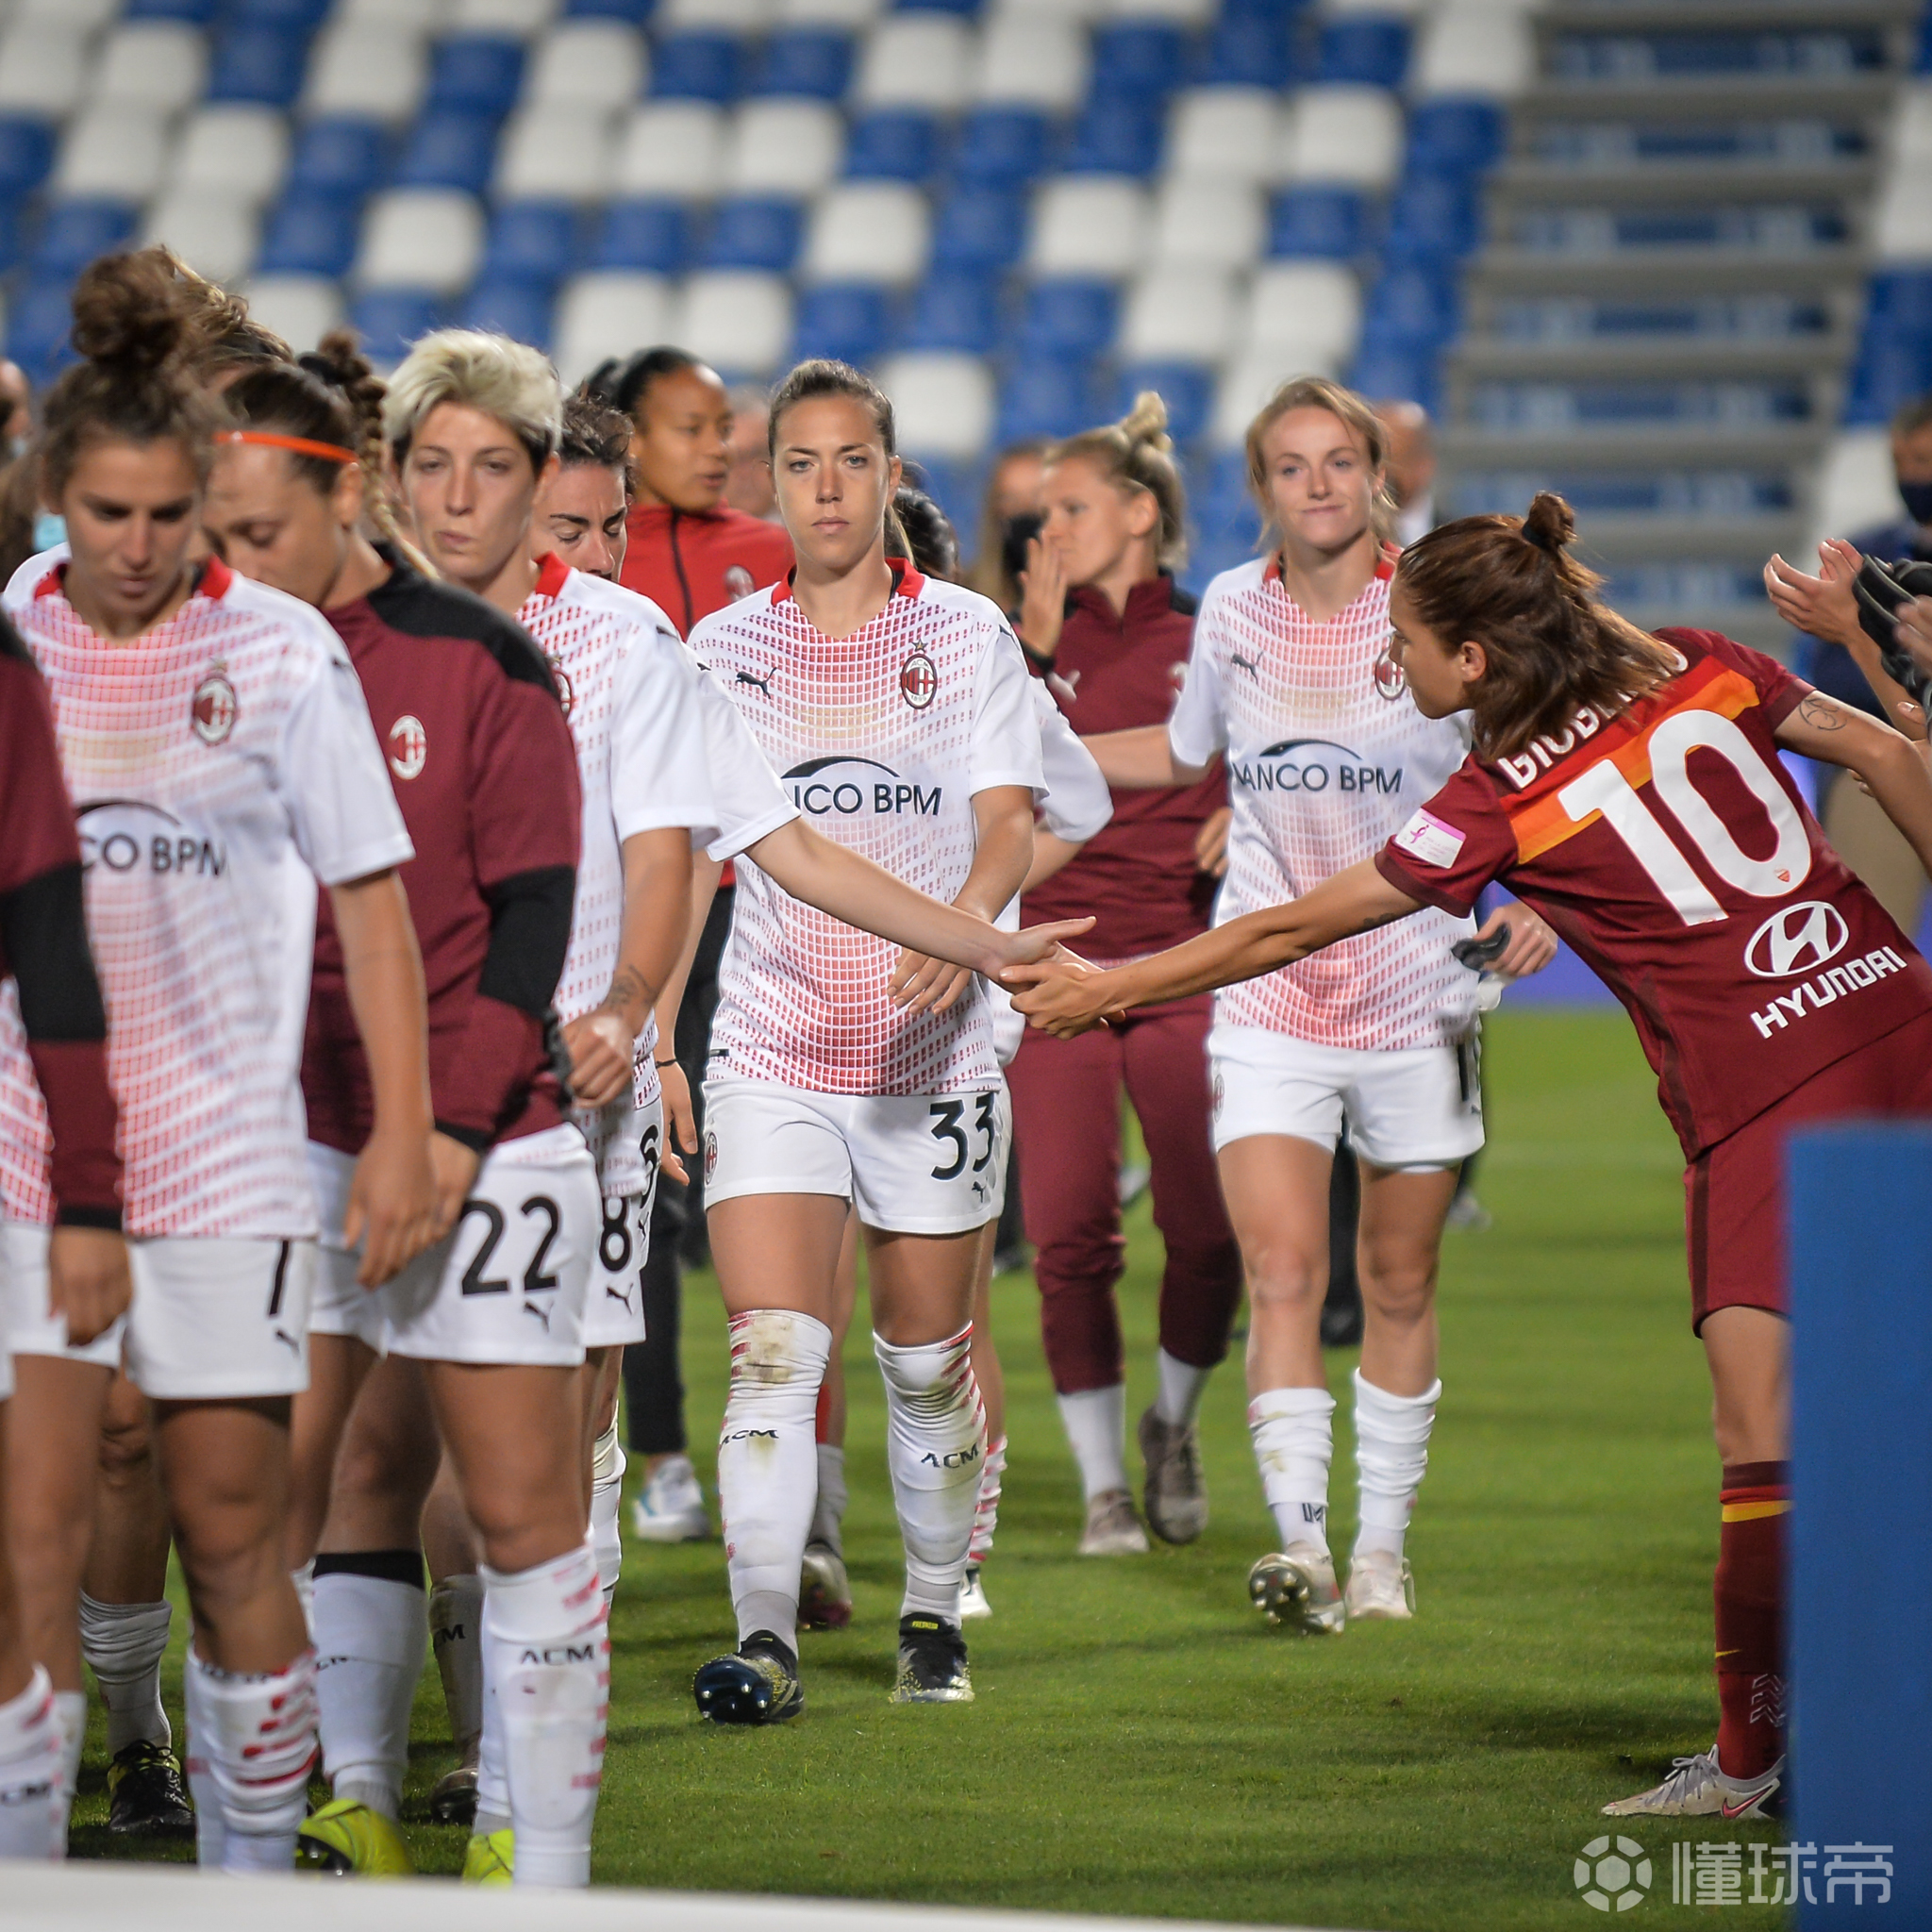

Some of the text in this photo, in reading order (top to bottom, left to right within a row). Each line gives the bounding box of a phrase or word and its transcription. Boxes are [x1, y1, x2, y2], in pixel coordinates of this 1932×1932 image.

[874, 783, 942, 816] BPM
[1232, 762, 1403, 794] ANCO BPM
[1557, 709, 1812, 926] 10
[1750, 945, 1908, 1040] HYUNDAI
[929, 1091, 995, 1180] 33
[460, 1195, 559, 1296] 22
[599, 1195, 630, 1273] 8
[920, 1441, 979, 1470] ACM
[520, 1644, 595, 1666] ACM
